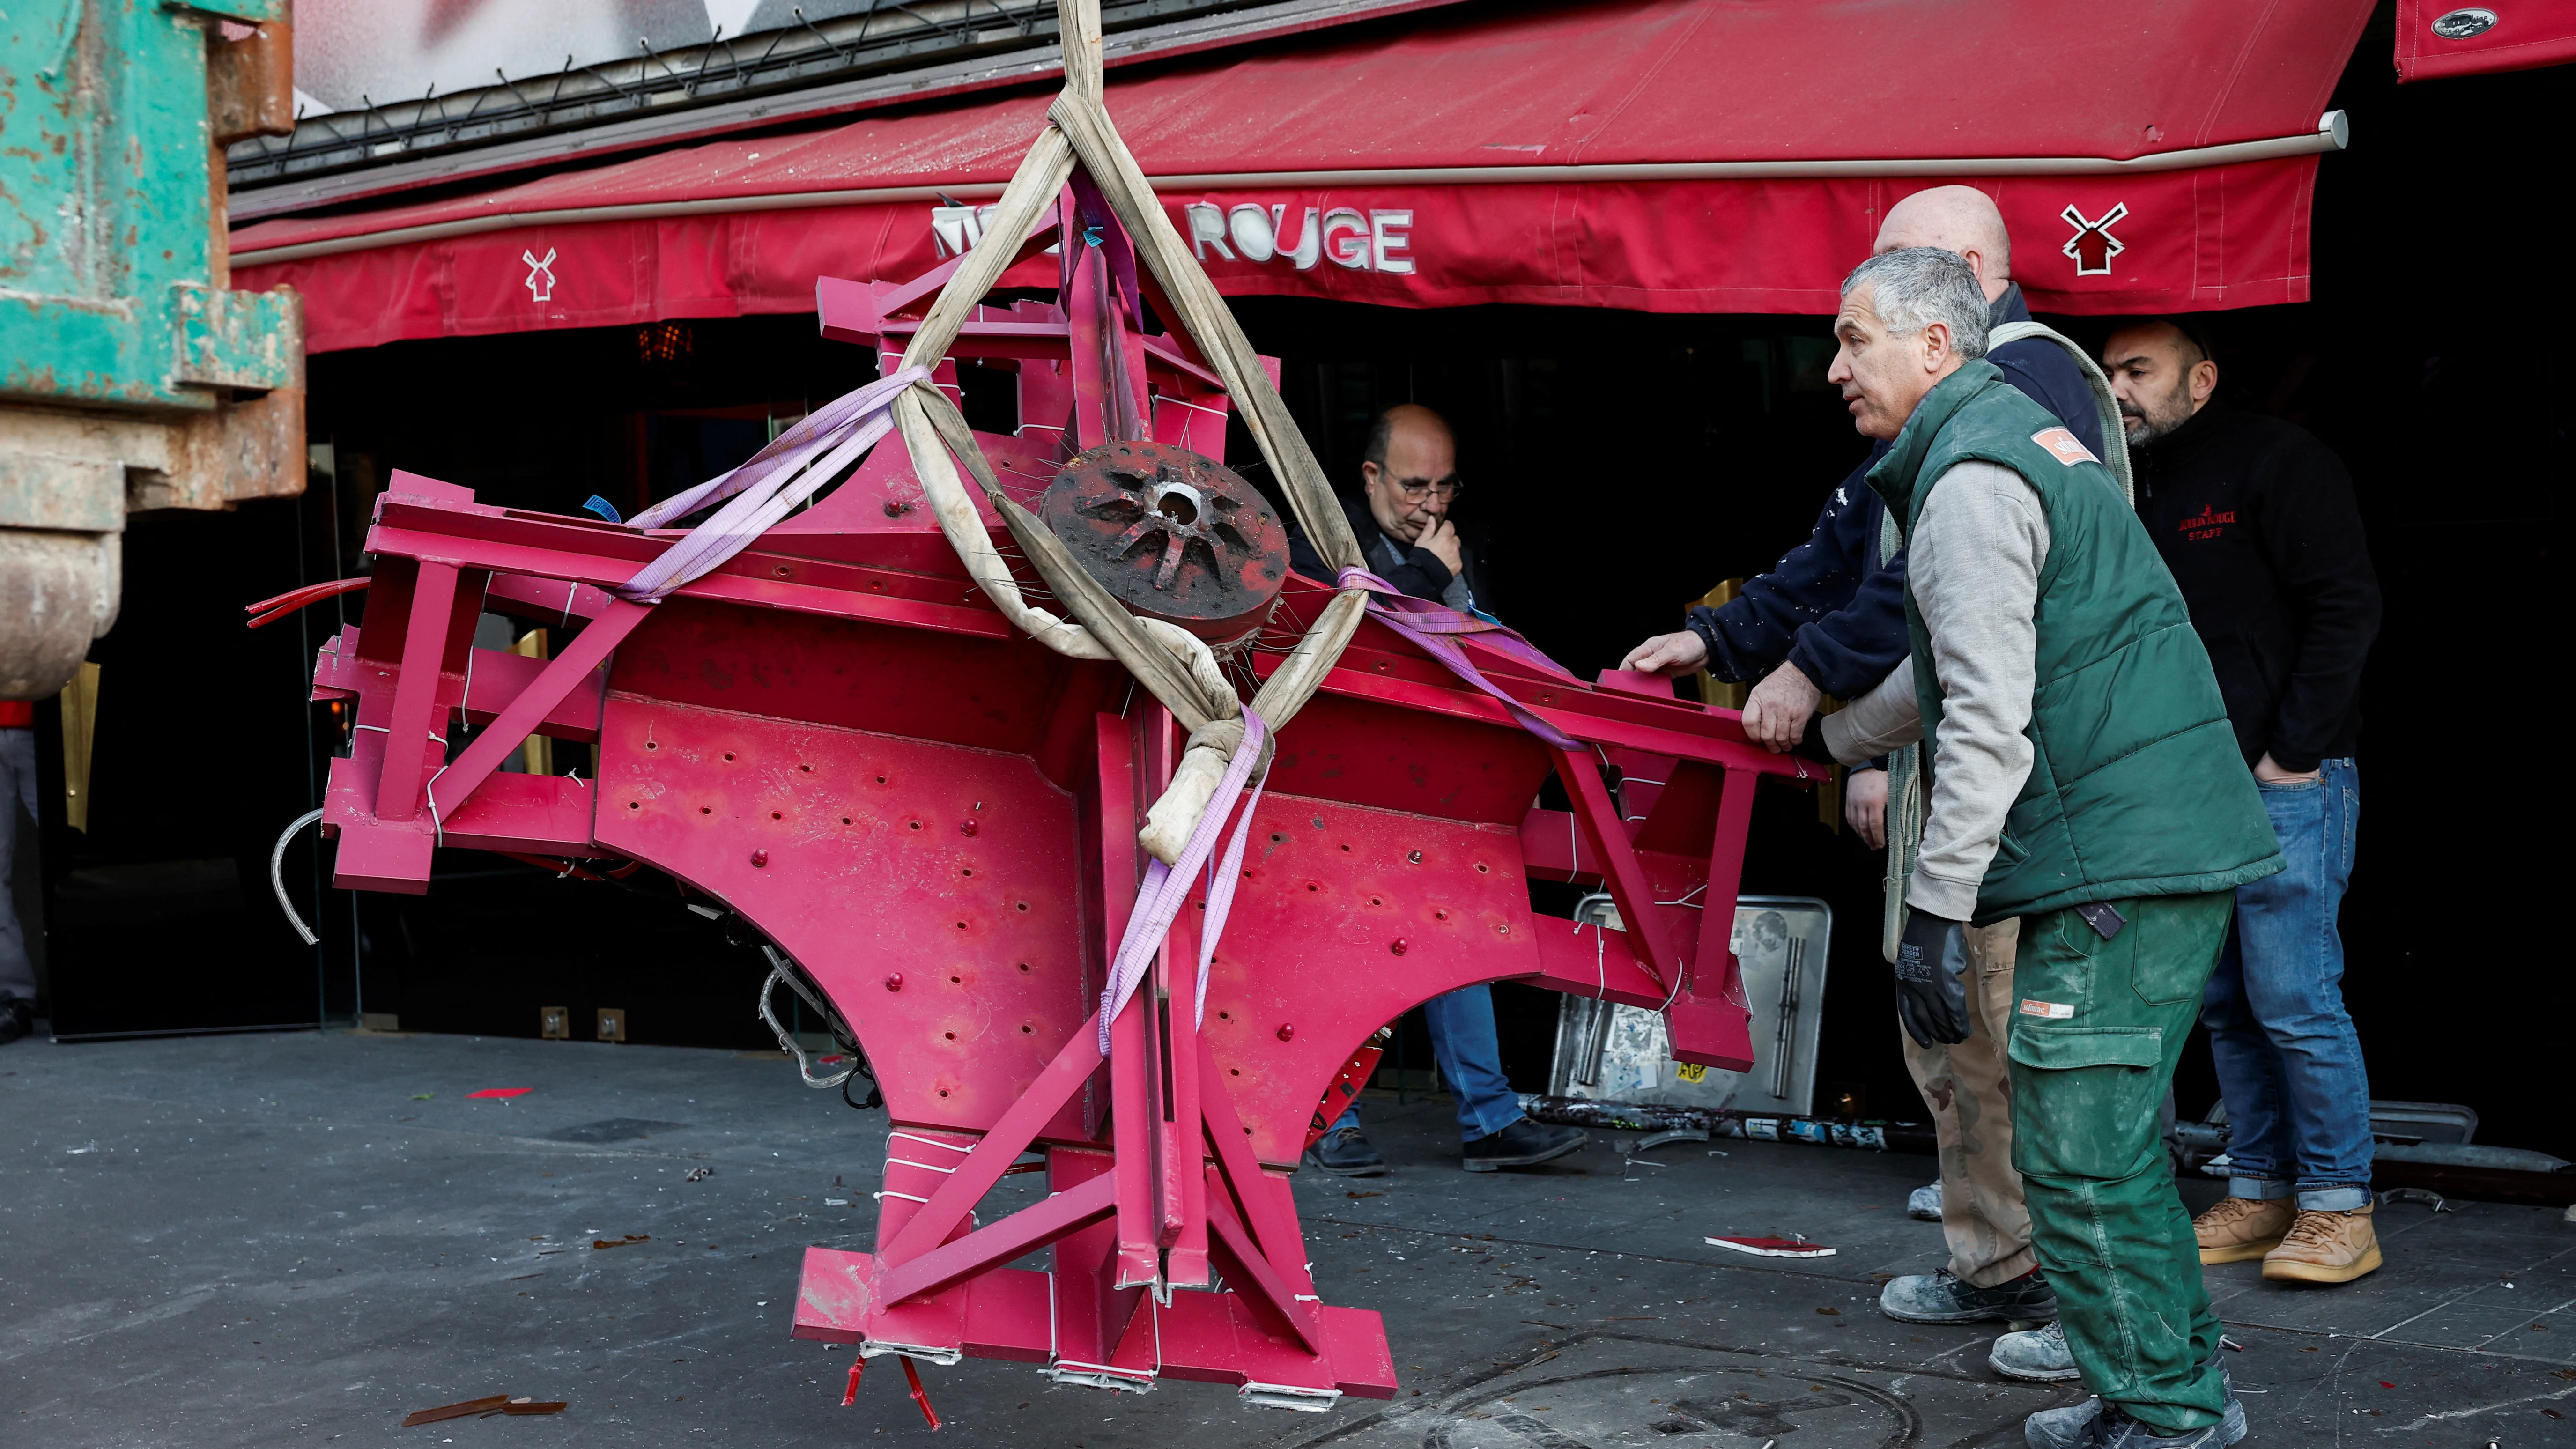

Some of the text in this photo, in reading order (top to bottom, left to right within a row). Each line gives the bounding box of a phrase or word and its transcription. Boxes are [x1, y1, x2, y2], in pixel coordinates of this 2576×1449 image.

[1184, 201, 1416, 275] ROUGE
[2189, 528, 2223, 540] STAFF
[2023, 1003, 2045, 1013] sofimac
